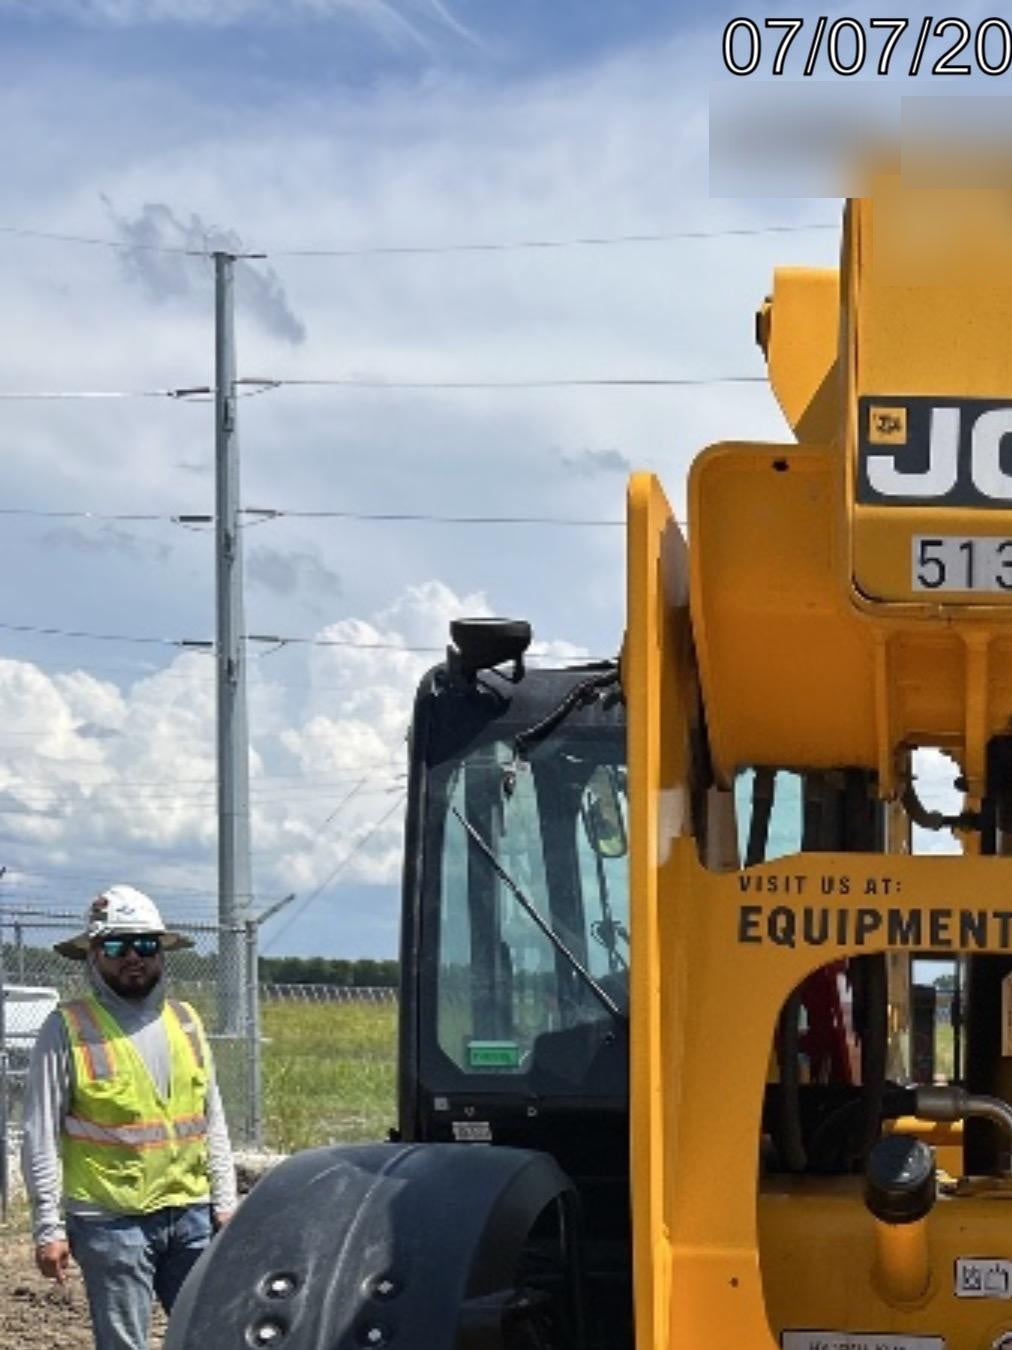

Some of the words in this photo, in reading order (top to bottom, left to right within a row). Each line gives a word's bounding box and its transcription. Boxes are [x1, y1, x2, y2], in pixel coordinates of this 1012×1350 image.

[739, 876, 806, 894] VISIT
[821, 877, 851, 895] US
[865, 879, 902, 895] AT:
